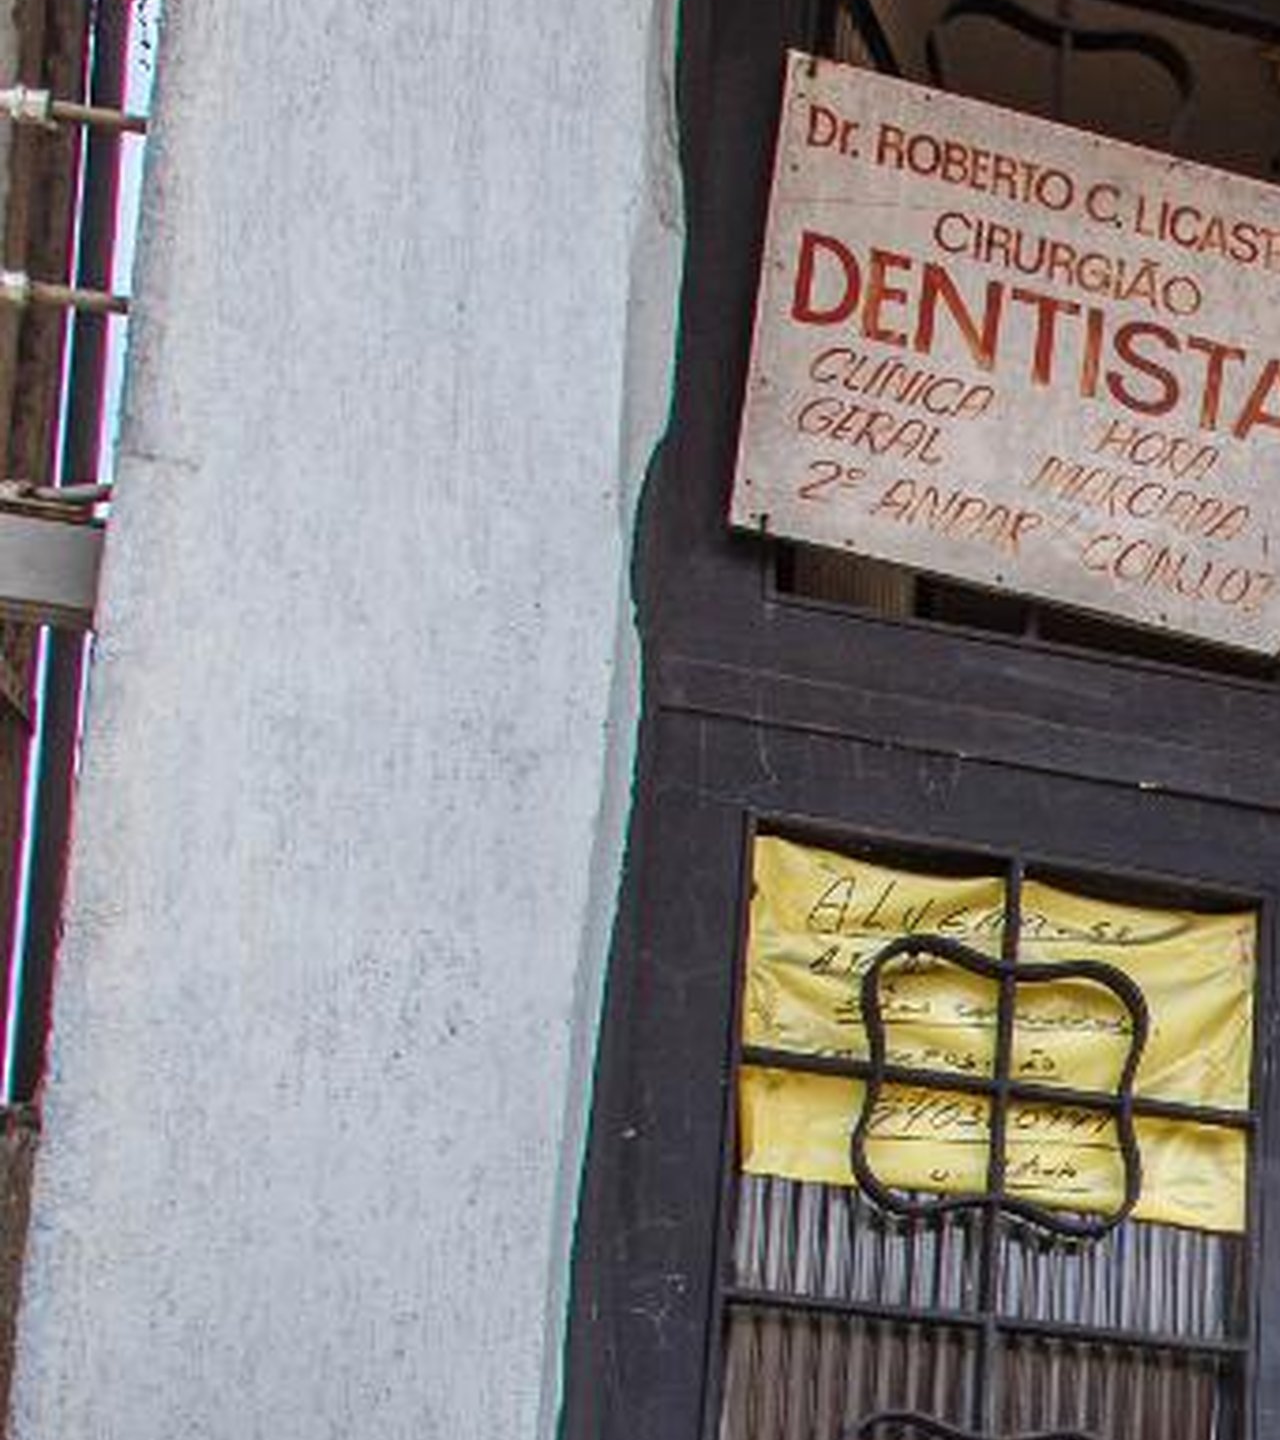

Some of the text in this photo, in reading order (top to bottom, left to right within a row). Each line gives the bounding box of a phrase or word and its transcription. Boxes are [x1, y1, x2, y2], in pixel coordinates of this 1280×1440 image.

[805, 104, 860, 158] Dr.
[875, 122, 1075, 211] ROBERTO
[1085, 183, 1123, 229] C.
[933, 211, 1202, 316] CIRURGIÃO
[797, 396, 942, 465] GERAL
[1094, 419, 1220, 481] HORA
[872, 478, 1044, 554] ANDAR
[1024, 456, 1251, 540] MARCADA
